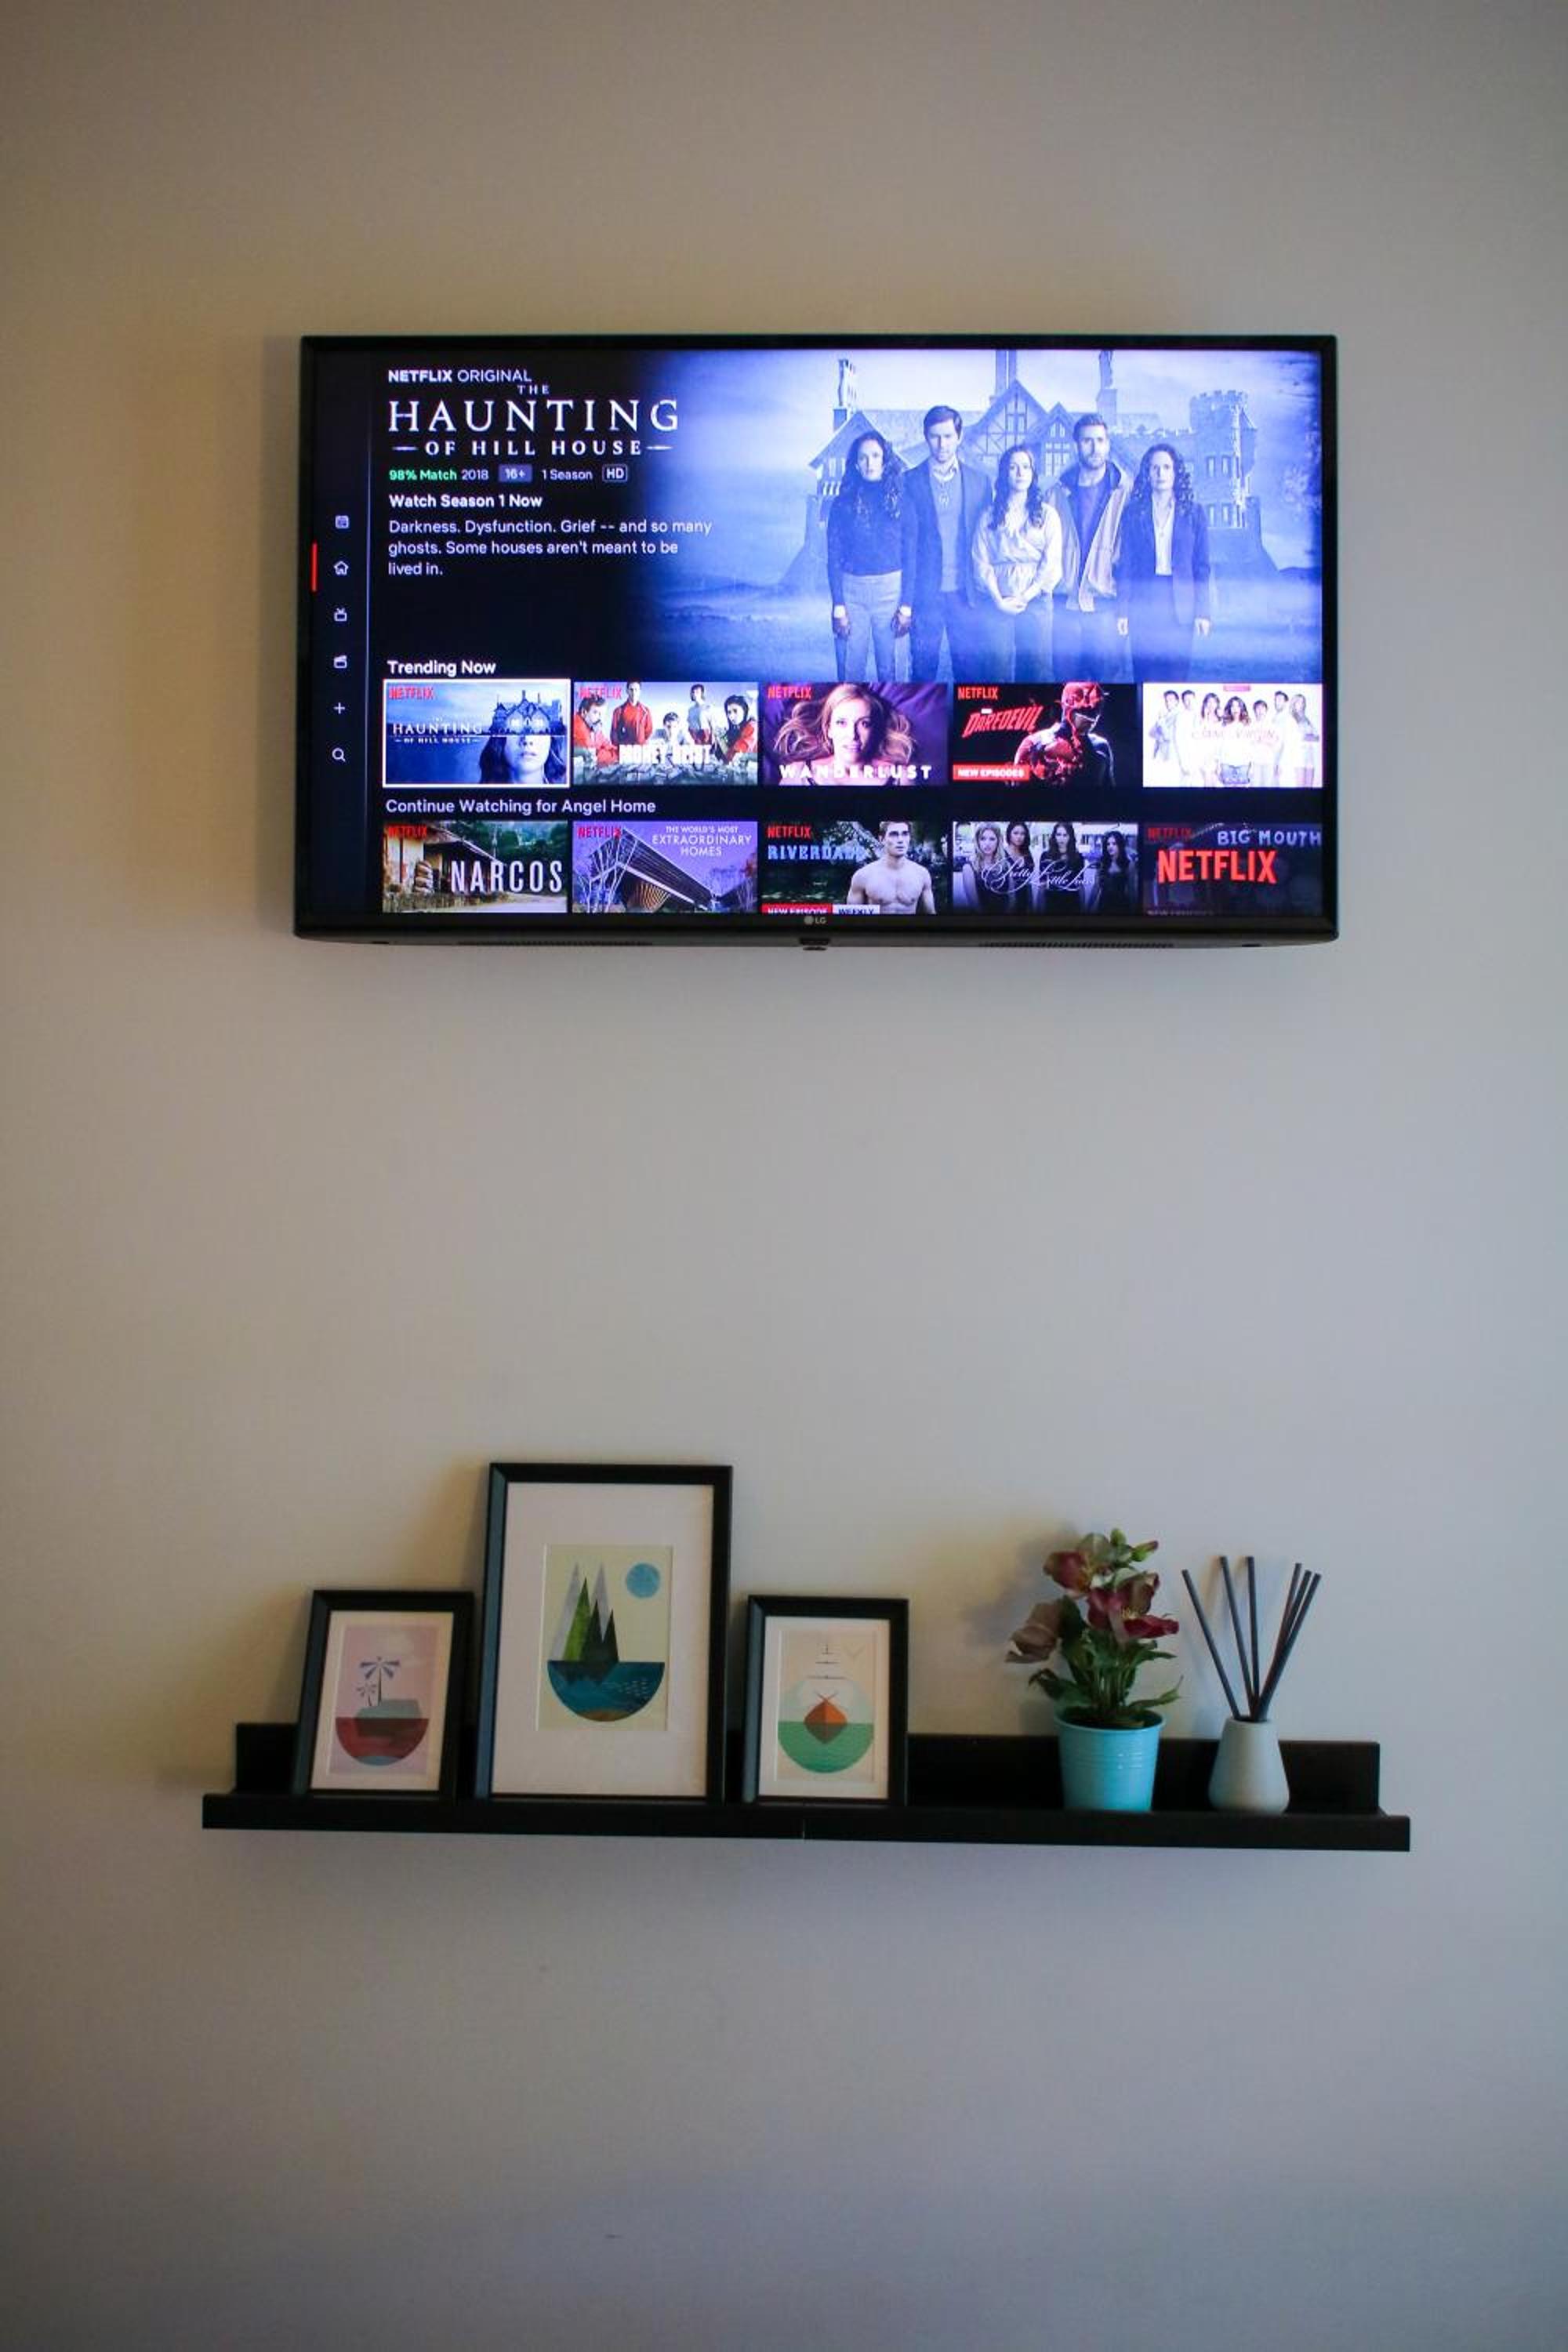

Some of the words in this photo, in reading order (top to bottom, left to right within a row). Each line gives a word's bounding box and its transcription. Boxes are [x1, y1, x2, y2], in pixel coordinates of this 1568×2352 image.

[388, 369, 452, 383] NETFLIX
[457, 368, 532, 383] ORIGINAL
[517, 384, 550, 394] THE
[388, 399, 678, 432] HAUNTING
[425, 441, 456, 456] OF
[472, 441, 535, 456] HILL
[551, 440, 641, 456] HOUSE
[389, 470, 417, 481] 98%
[419, 470, 457, 481] Match
[461, 470, 489, 481] 2018
[505, 468, 525, 480] 16+
[543, 470, 546, 480] 1
[550, 469, 593, 481] Season
[606, 468, 625, 479] HD
[389, 494, 437, 507] Watch
[441, 494, 495, 507] Season
[499, 494, 505, 506] 1
[510, 494, 543, 507] Now
[389, 520, 461, 533] Darkness.
[465, 519, 556, 535] Dysfunction.
[561, 519, 596, 532] Grief
[619, 519, 647, 532] and
[651, 521, 668, 532] so
[672, 521, 712, 536] many
[388, 541, 441, 557] ghosts.
[446, 541, 488, 554] Some
[492, 541, 543, 554] houses
[546, 541, 587, 554] aren't
[592, 541, 637, 554] meant
[641, 541, 655, 554] to
[660, 540, 678, 554] be
[388, 562, 422, 575] lived
[426, 562, 443, 575] in.
[387, 660, 457, 677] Trending
[461, 660, 496, 674] Now
[388, 686, 434, 700] NETFLIX
[579, 686, 622, 699] NETFLIX
[768, 684, 812, 699] NETFLIX
[957, 686, 999, 700] NETFLIX
[393, 723, 482, 735] HAUNTING
[962, 706, 1044, 738] DAREDEVIL
[779, 764, 932, 780] WANDERLUST
[958, 768, 978, 777] NEW
[981, 768, 1025, 778] EPISODES
[386, 800, 455, 813] Continue
[459, 800, 532, 815] Watching
[536, 800, 557, 813] for
[562, 800, 606, 815] Angel
[611, 799, 656, 813] Home
[388, 826, 427, 838] NETFLIX
[577, 827, 622, 839] NETFLIX
[768, 826, 811, 838] NETFLIX
[1217, 830, 1251, 846] BIG
[1258, 831, 1322, 848] MOUTH
[652, 835, 753, 845] EXTRAORDINARY
[681, 847, 723, 857] HOMES
[1157, 850, 1277, 884] NETFLIX
[451, 860, 563, 893] NARCOS
